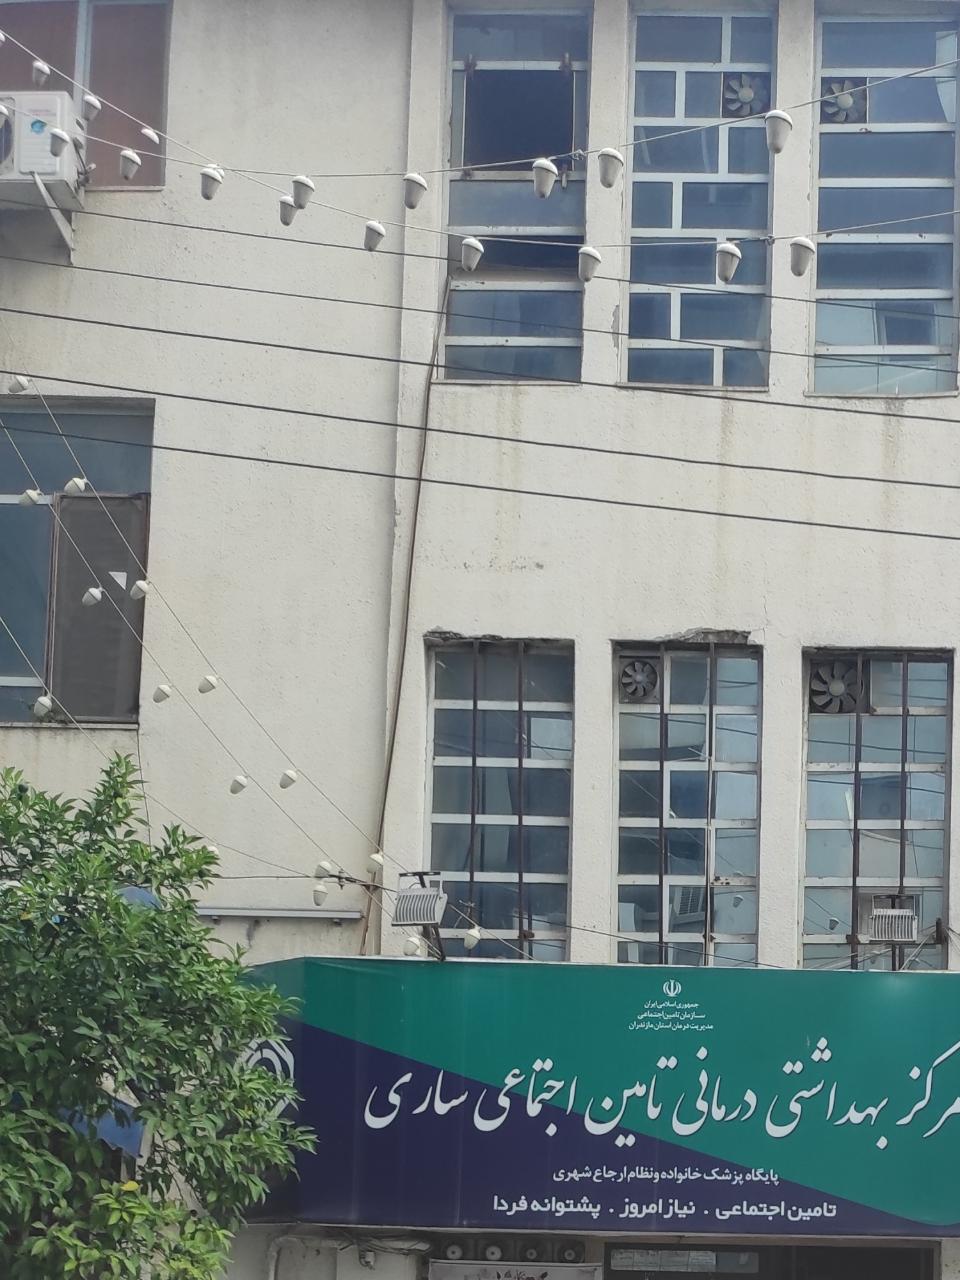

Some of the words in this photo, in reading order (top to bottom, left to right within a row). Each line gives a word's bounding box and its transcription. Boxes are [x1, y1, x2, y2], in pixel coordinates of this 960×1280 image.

[644, 1000, 657, 1009] ایران
[657, 1001, 676, 1009] اسلامی
[672, 1022, 689, 1031] درمان
[680, 1012, 705, 1021] سازمان
[690, 1023, 714, 1031] مدیریت
[364, 1068, 469, 1130] ساری
[473, 1057, 578, 1137] اجتماعی
[671, 1045, 758, 1136] درمانی
[764, 1036, 889, 1150] بهداشتی
[584, 1055, 678, 1148] تامین
[553, 1165, 592, 1182] شهری
[592, 1165, 628, 1183] ارجاع
[661, 1166, 702, 1184] خانواده
[703, 1167, 744, 1185] پزشک
[745, 1168, 779, 1186] پایگاه
[493, 1195, 529, 1216] فردا
[530, 1195, 602, 1220] پشتوانه
[619, 1198, 663, 1219] امروز
[664, 1199, 696, 1219] نیاز
[715, 1200, 786, 1221] اجتماعی
[787, 1201, 837, 1221] تامین
